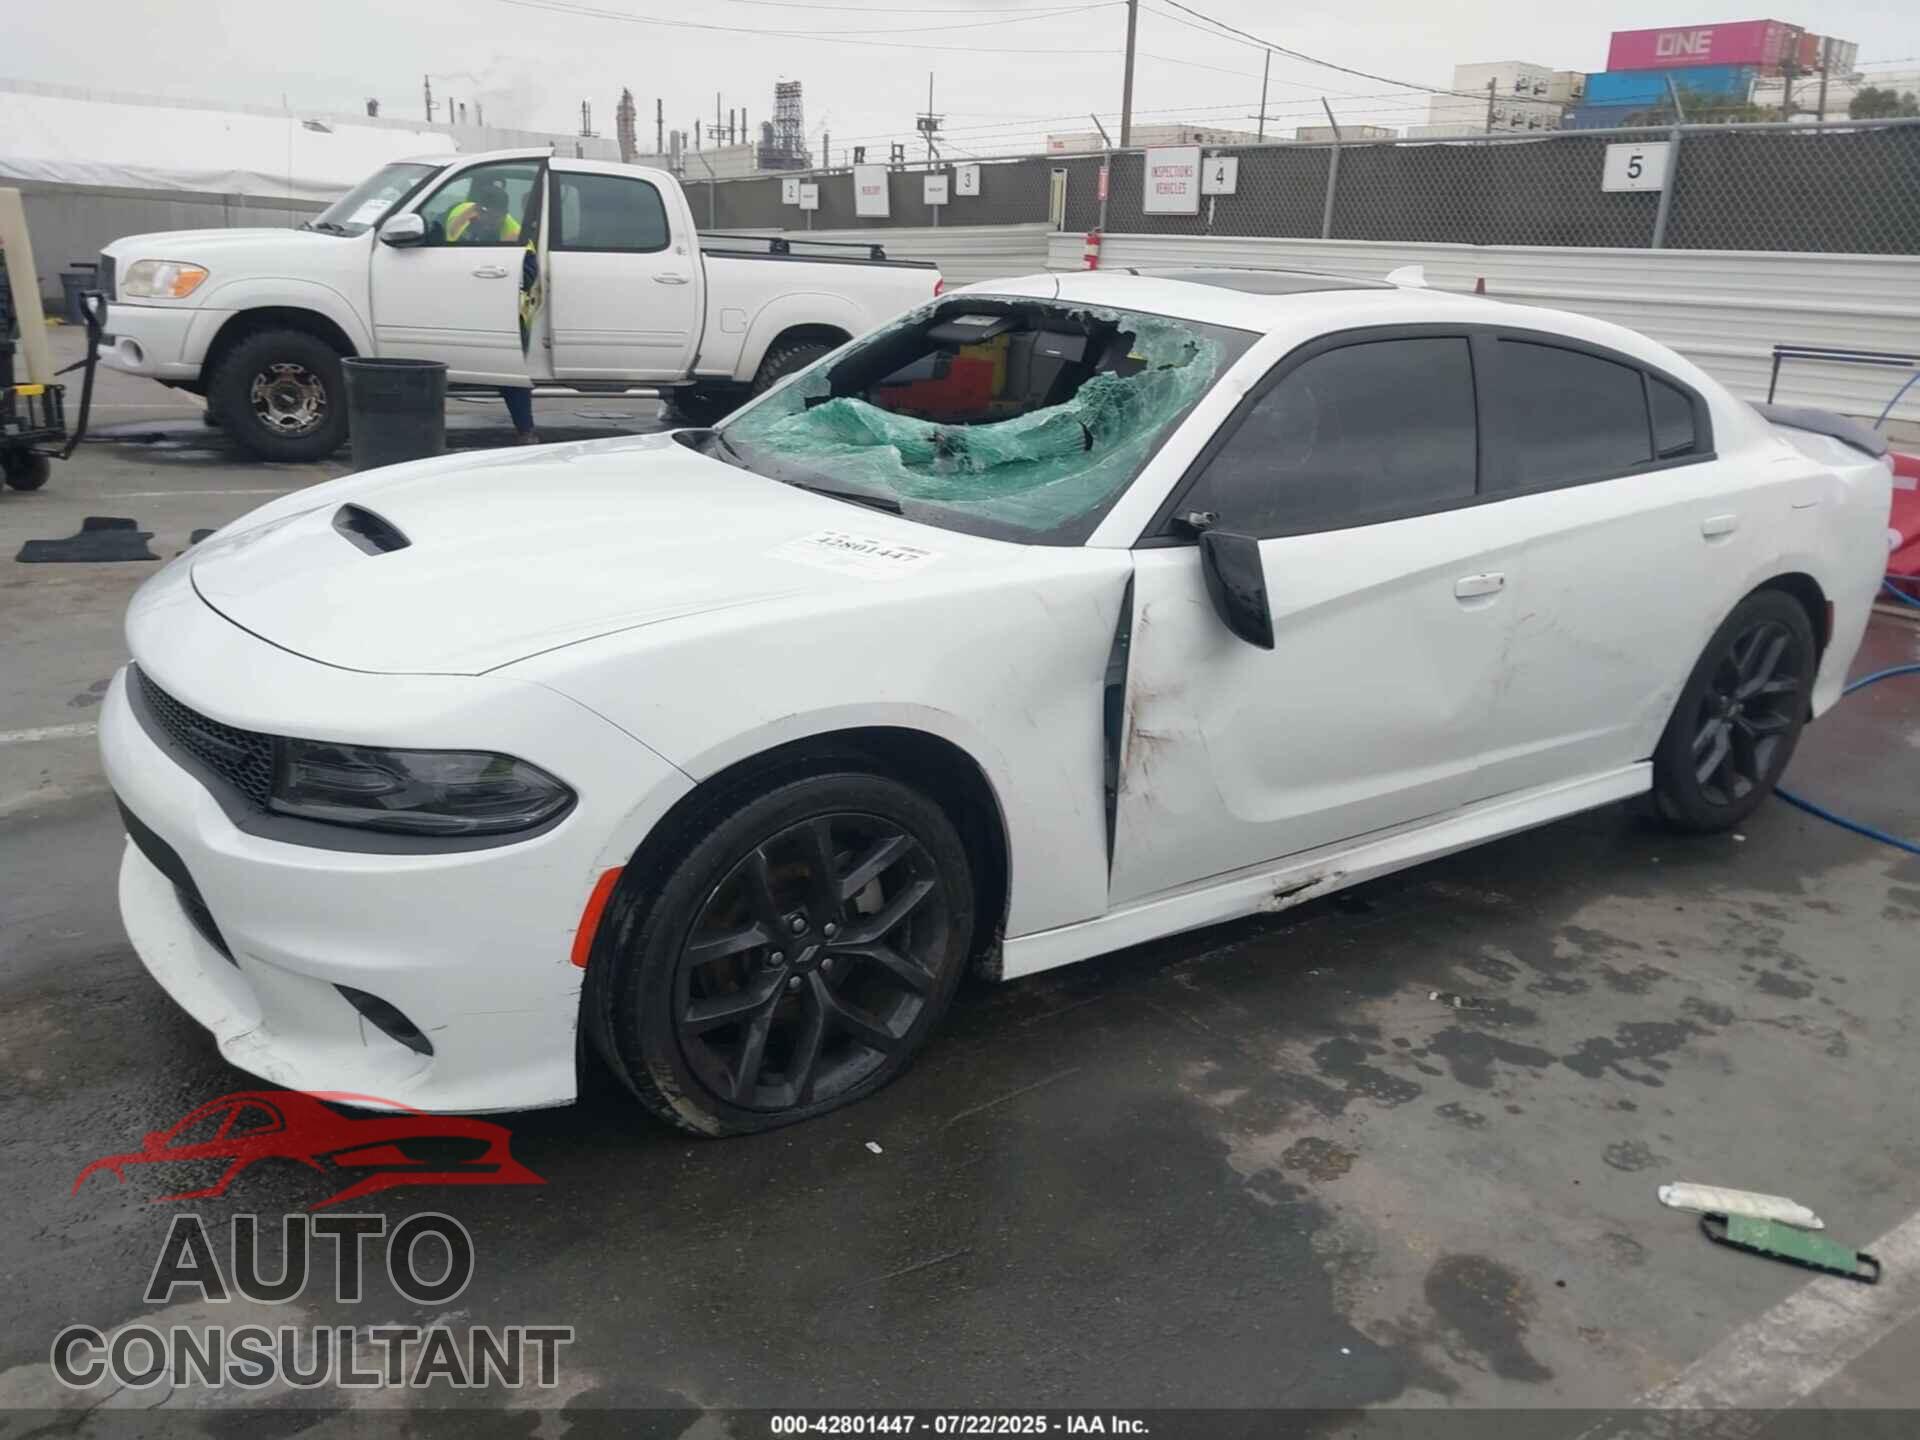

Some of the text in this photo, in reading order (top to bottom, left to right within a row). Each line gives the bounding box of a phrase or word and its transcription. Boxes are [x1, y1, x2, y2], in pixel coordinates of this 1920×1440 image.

[1655, 29, 1713, 57] ONE
[1215, 167, 1224, 185] 4
[1627, 155, 1643, 179] 5
[964, 172, 972, 188] 3
